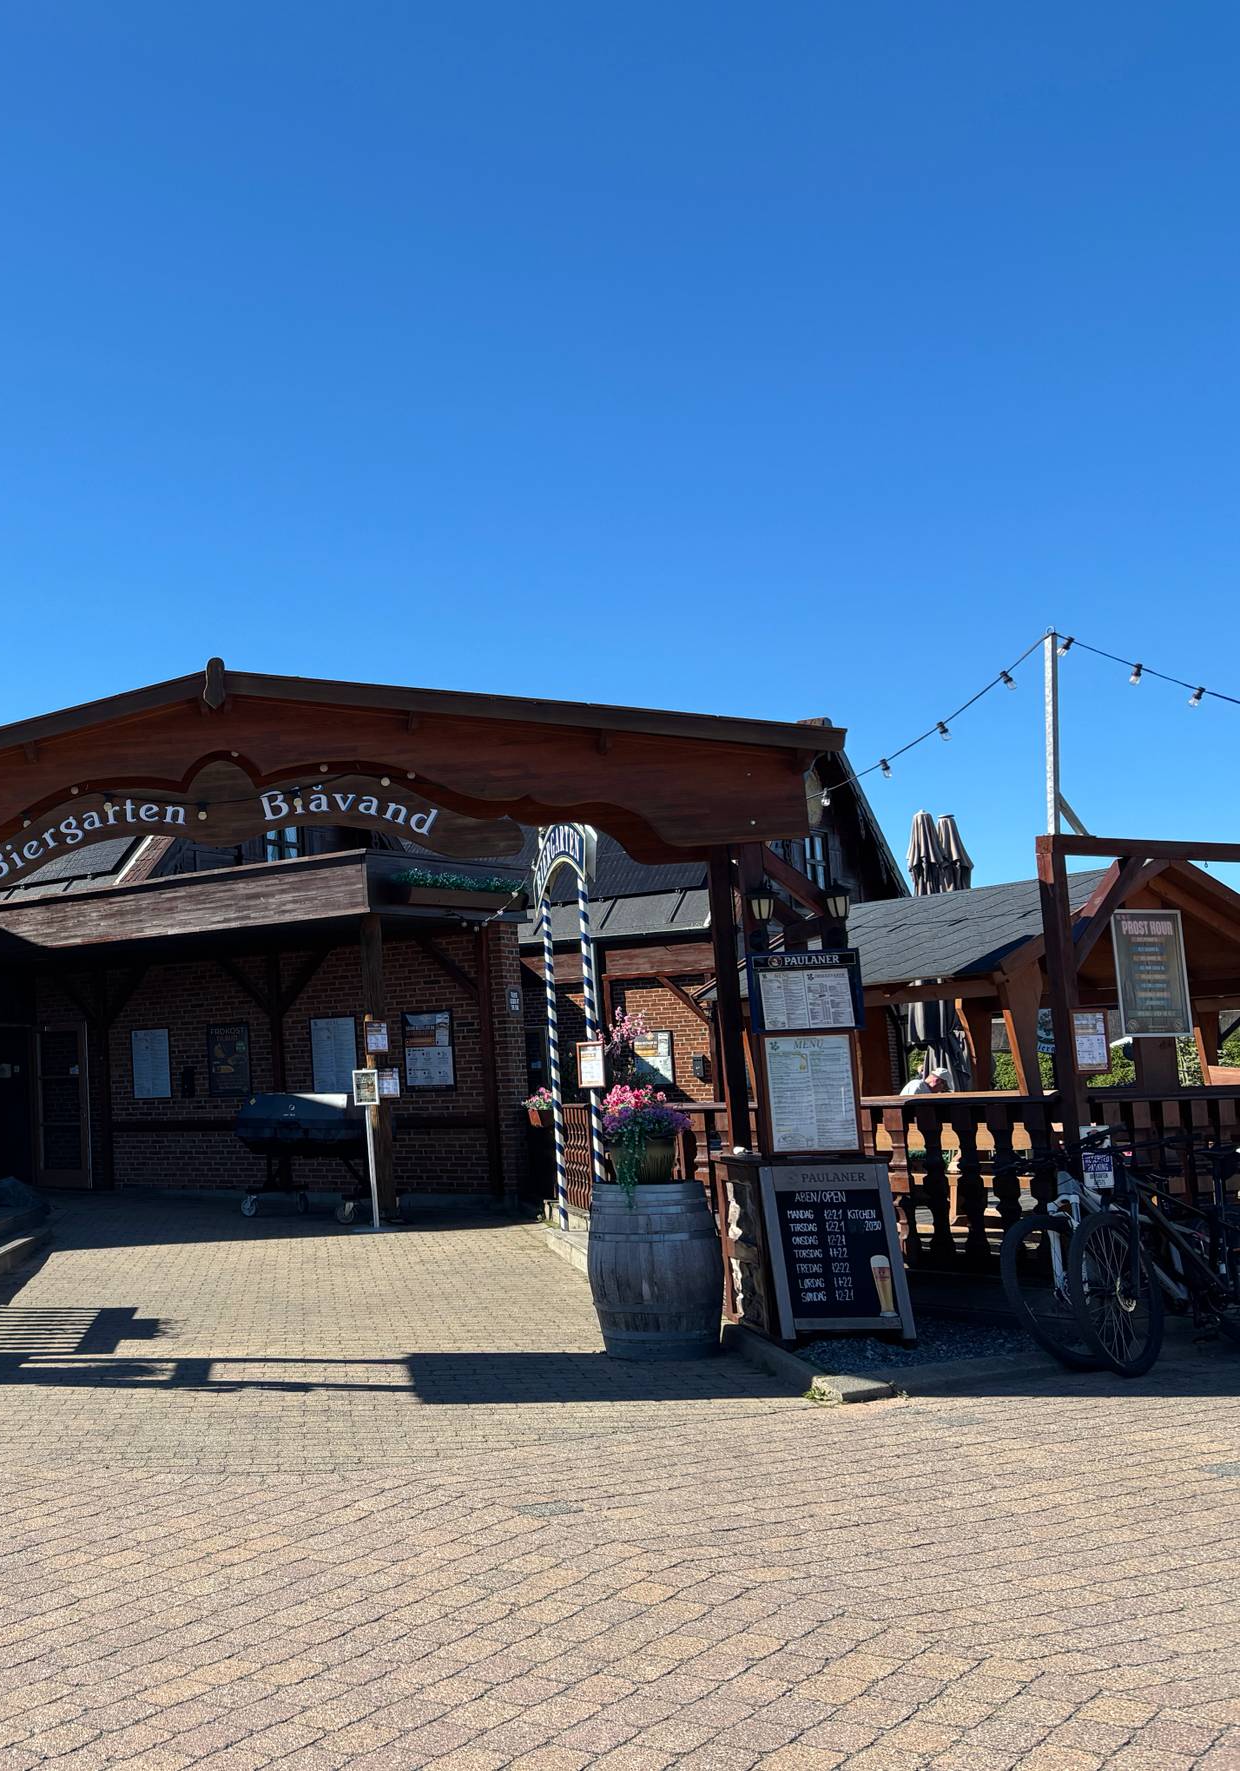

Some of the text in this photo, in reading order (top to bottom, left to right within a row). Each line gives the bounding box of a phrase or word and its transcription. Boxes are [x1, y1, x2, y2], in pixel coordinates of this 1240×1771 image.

[260, 784, 438, 836] Blåvand
[536, 824, 580, 897] BIERGARTEN
[1121, 920, 1173, 936] PROST HOUR
[784, 955, 840, 966] PAULANER
[794, 1039, 823, 1050] MENU
[802, 1172, 867, 1184] PAULANER
[787, 1210, 814, 1219] MANDAG
[789, 1223, 818, 1232] TIRSDAG
[792, 1235, 819, 1245] ONSDAG
[793, 1249, 823, 1258] TORSDAG
[796, 1263, 823, 1273] FREDAG
[799, 1277, 825, 1289] LØRDAG
[801, 1291, 827, 1302] SØNDAG
